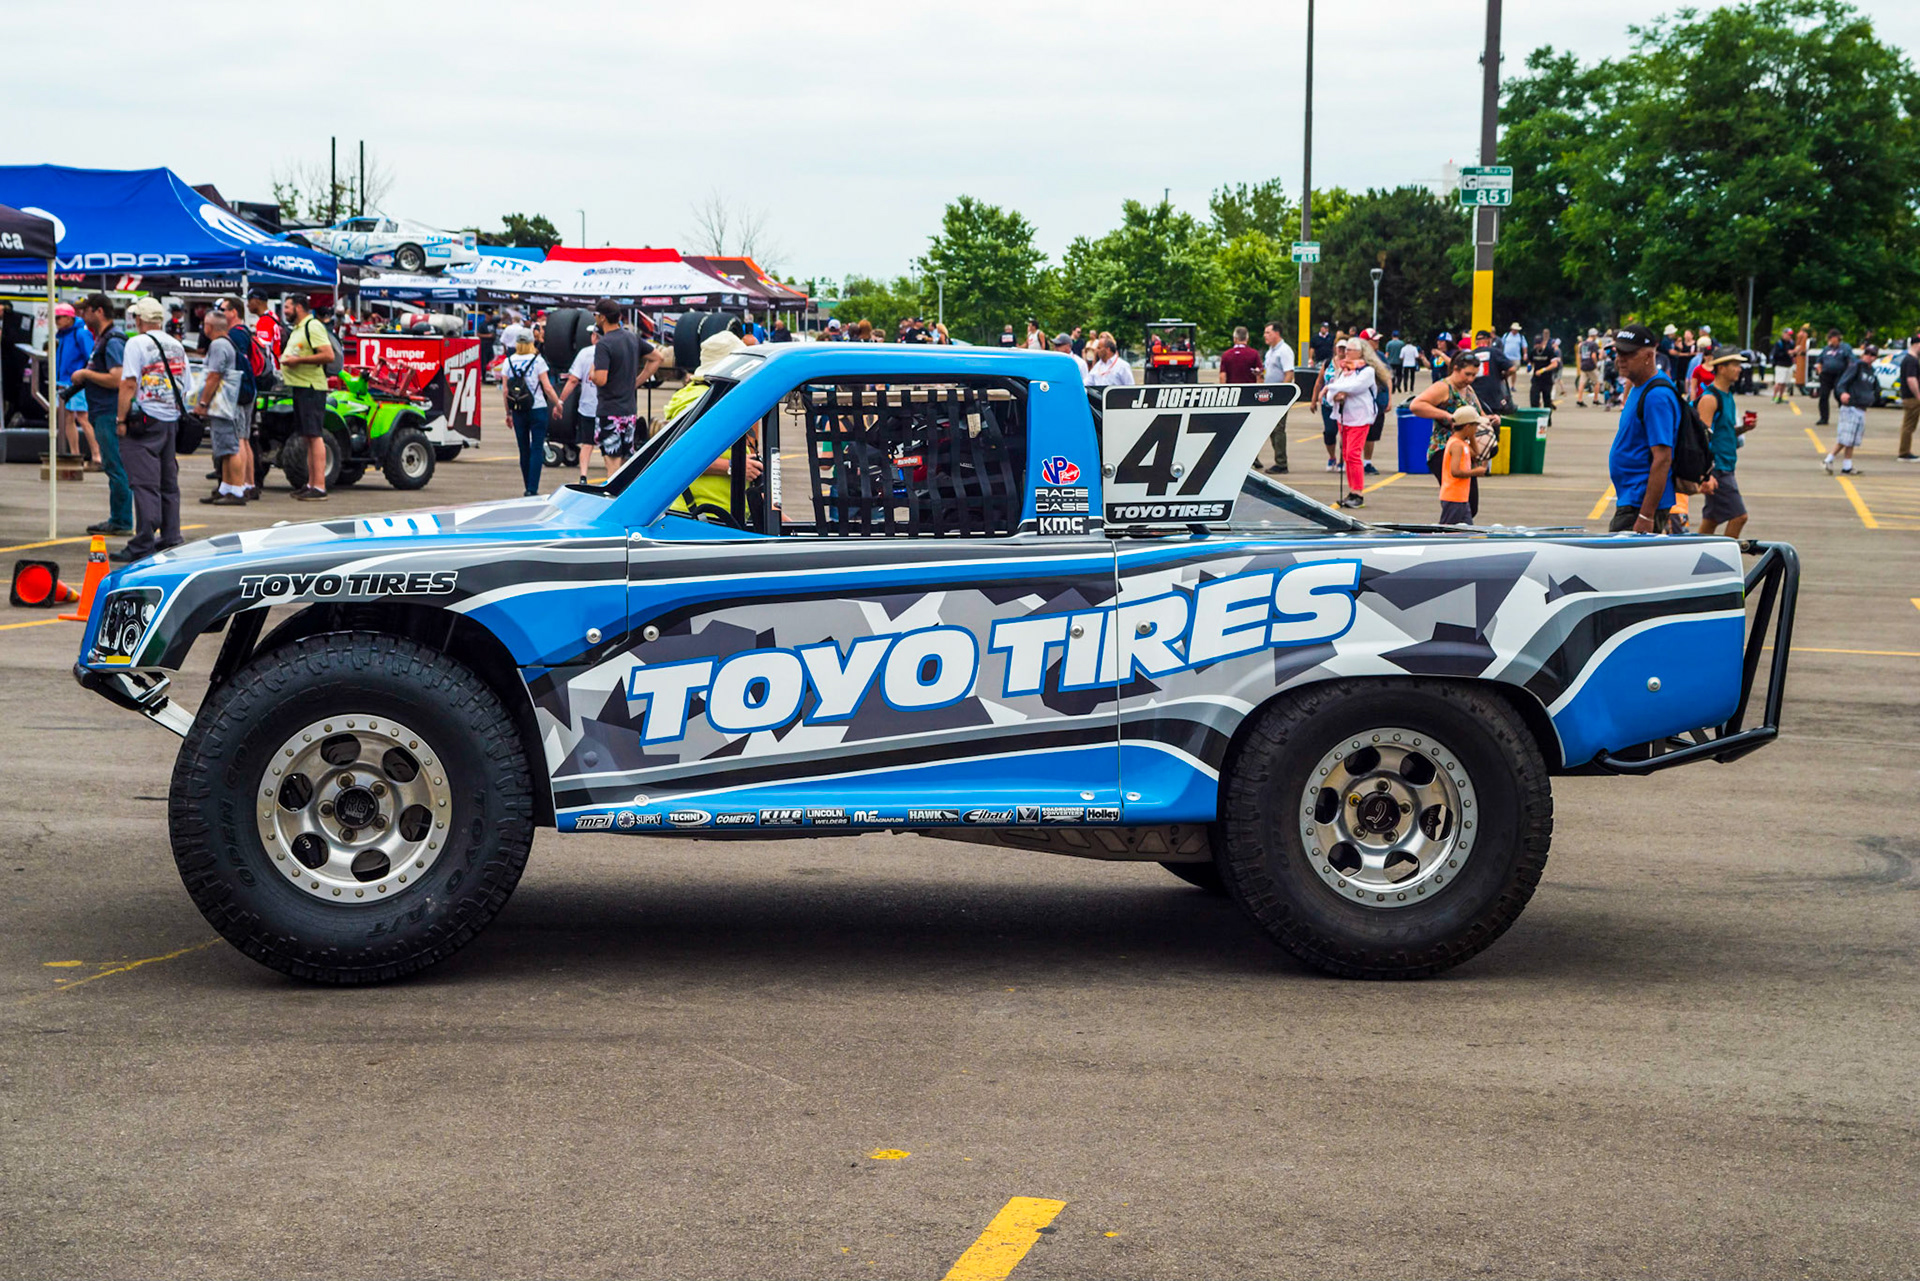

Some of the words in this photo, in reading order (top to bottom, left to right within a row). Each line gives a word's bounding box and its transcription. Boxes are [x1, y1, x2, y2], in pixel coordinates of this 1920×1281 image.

[1475, 189, 1509, 203] 851
[332, 233, 370, 260] 64
[54, 252, 190, 270] MOPAR
[385, 347, 425, 360] Bumper
[446, 368, 478, 430] 74
[1131, 388, 1148, 409] J.
[1155, 387, 1242, 408] HOFFMAN
[1114, 412, 1251, 496] 47
[1042, 456, 1068, 485] VP
[1035, 488, 1089, 498] RACE
[1036, 502, 1089, 512] CASE
[1114, 505, 1167, 520] TOYO
[1168, 503, 1225, 518] TIRES
[1039, 517, 1085, 532] KMC
[239, 573, 346, 598] TOYO
[347, 571, 459, 596] TIRES
[626, 624, 981, 746] TOYO
[990, 558, 1363, 697] TIRES
[636, 814, 661, 825] SUPPLY
[669, 812, 700, 821] TECHNI
[716, 813, 756, 824] COMETIC
[761, 810, 802, 819] KING
[807, 809, 843, 818] LINCOLN
[909, 810, 942, 819] HAWK
[1087, 809, 1119, 821] Holley
